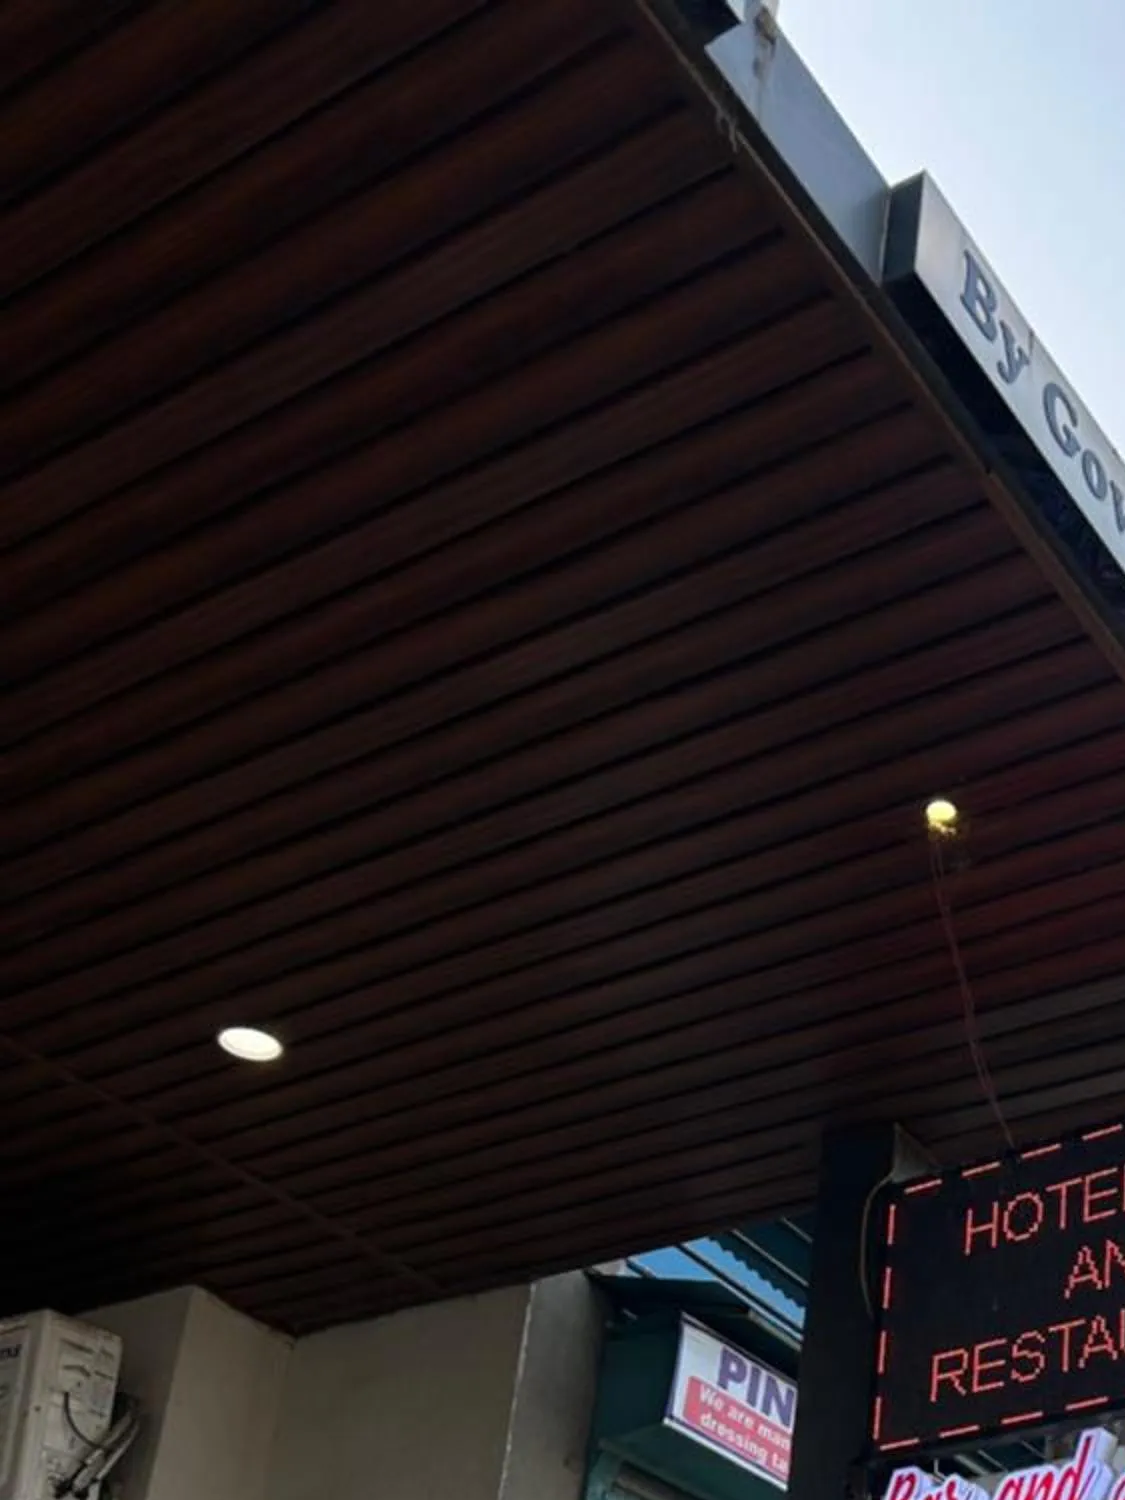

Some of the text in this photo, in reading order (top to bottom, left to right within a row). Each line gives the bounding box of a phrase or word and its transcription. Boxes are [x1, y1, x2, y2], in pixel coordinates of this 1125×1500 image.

[959, 248, 1030, 384] By
[699, 1383, 723, 1412] We
[727, 1404, 754, 1427] are
[700, 1411, 769, 1464] dressing
